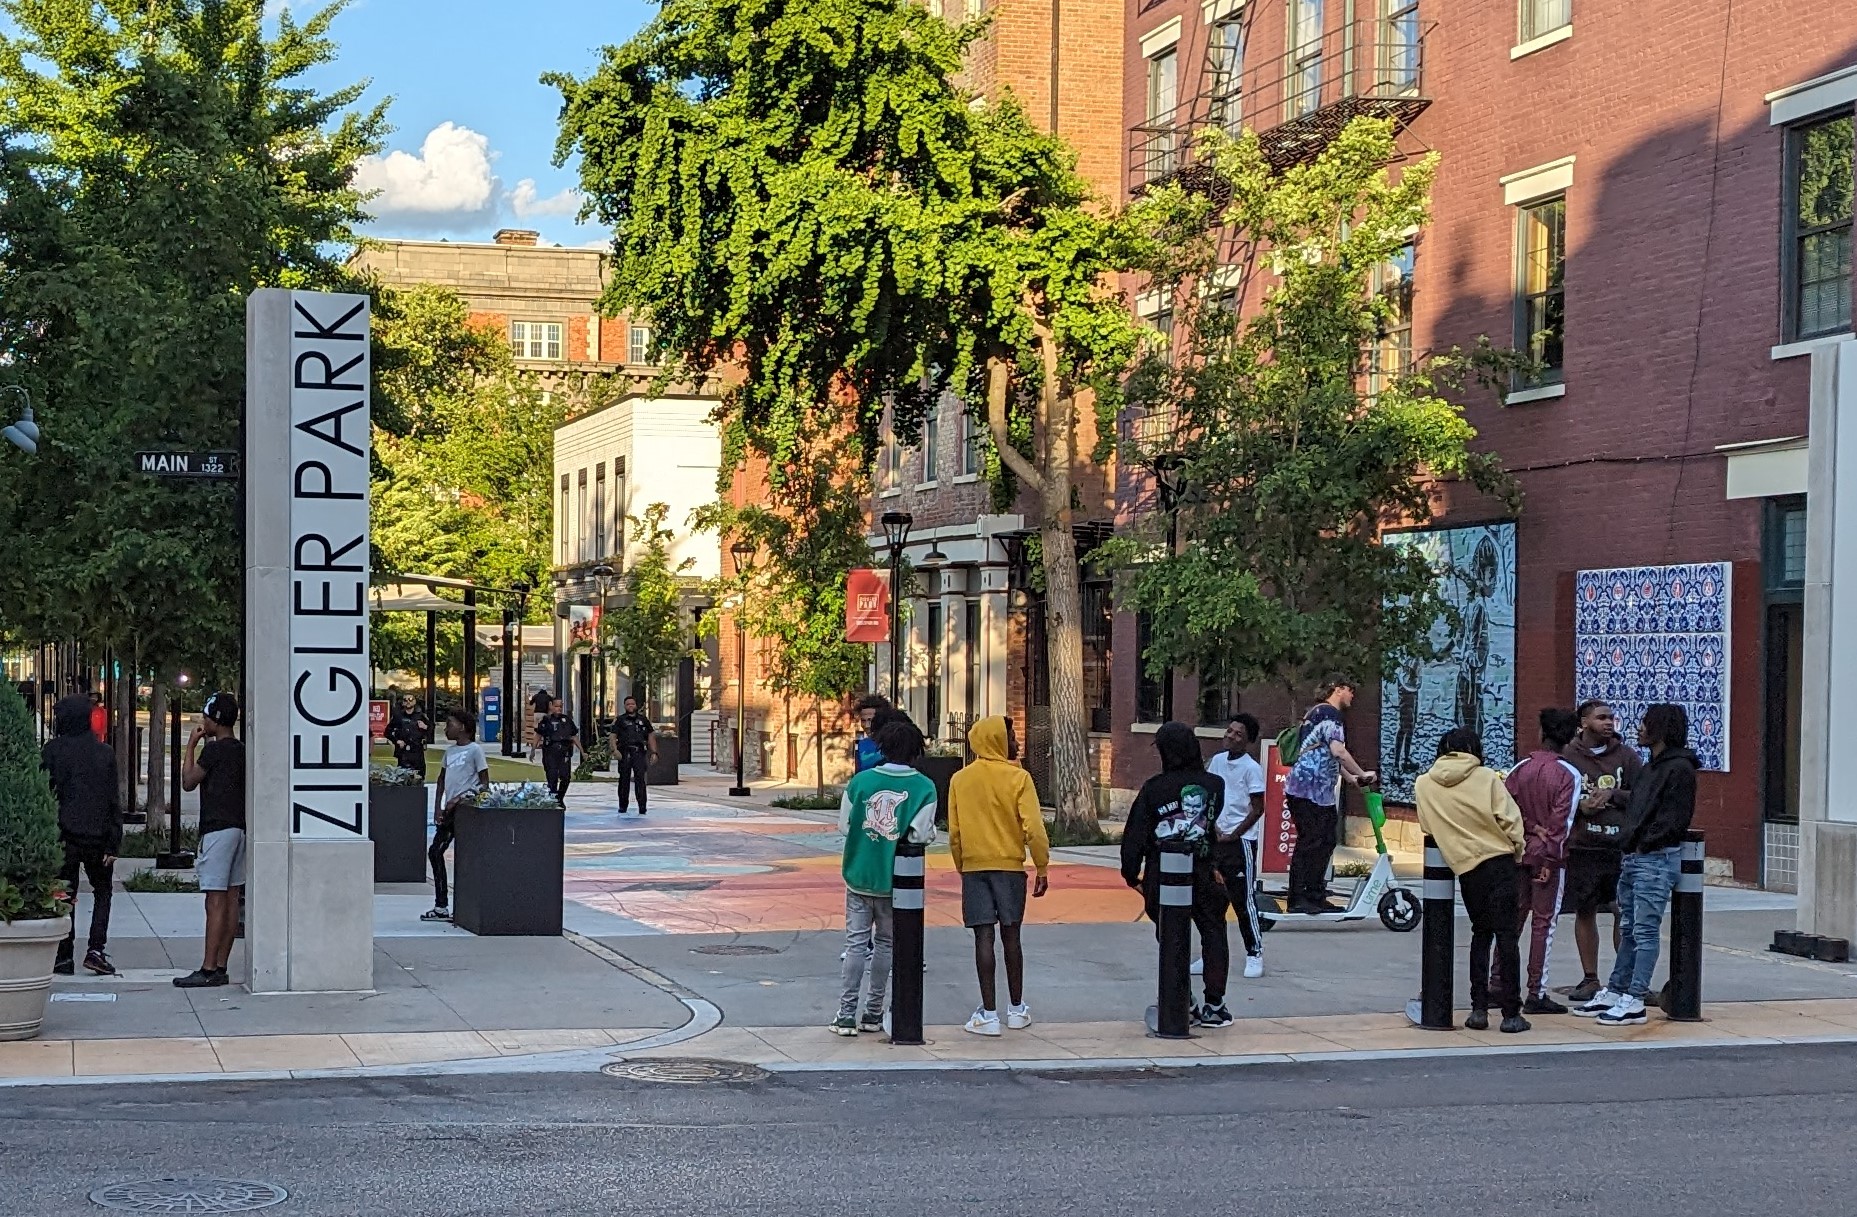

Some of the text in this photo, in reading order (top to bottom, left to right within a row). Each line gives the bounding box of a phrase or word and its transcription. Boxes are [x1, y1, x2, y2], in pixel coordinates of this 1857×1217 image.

[141, 454, 189, 472] MAIN
[209, 456, 218, 464] ST
[201, 463, 224, 473] 1322
[293, 299, 365, 836] ZIEGLER PARK
